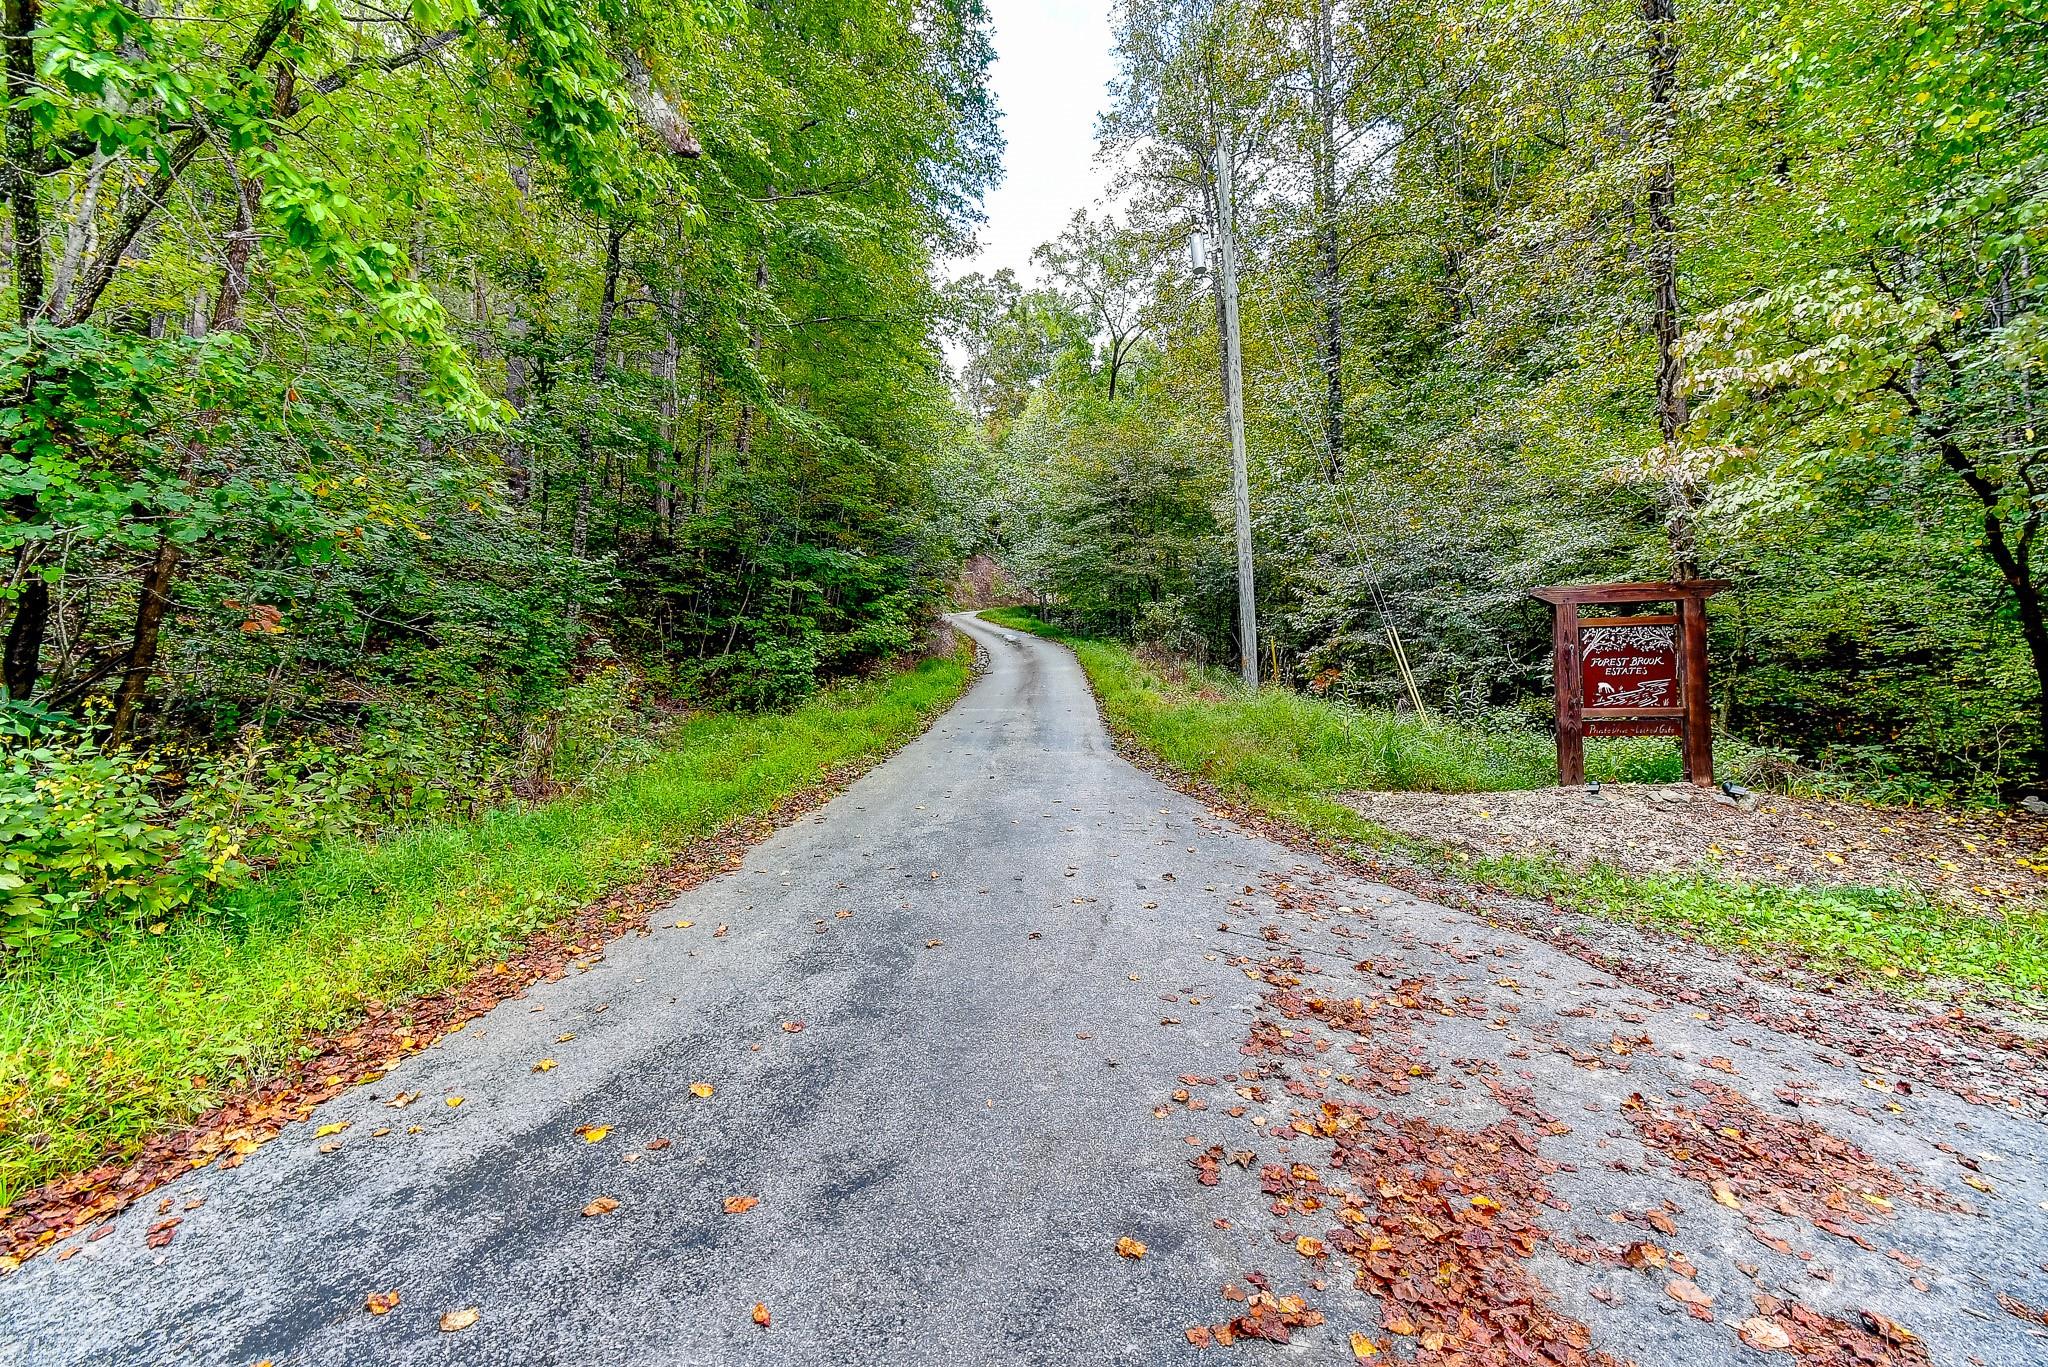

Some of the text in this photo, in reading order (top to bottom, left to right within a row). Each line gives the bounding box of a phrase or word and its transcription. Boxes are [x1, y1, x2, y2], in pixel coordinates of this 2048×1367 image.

[1590, 656, 1665, 667] FOREST BROOK
[1605, 666, 1648, 676] ESTATES
